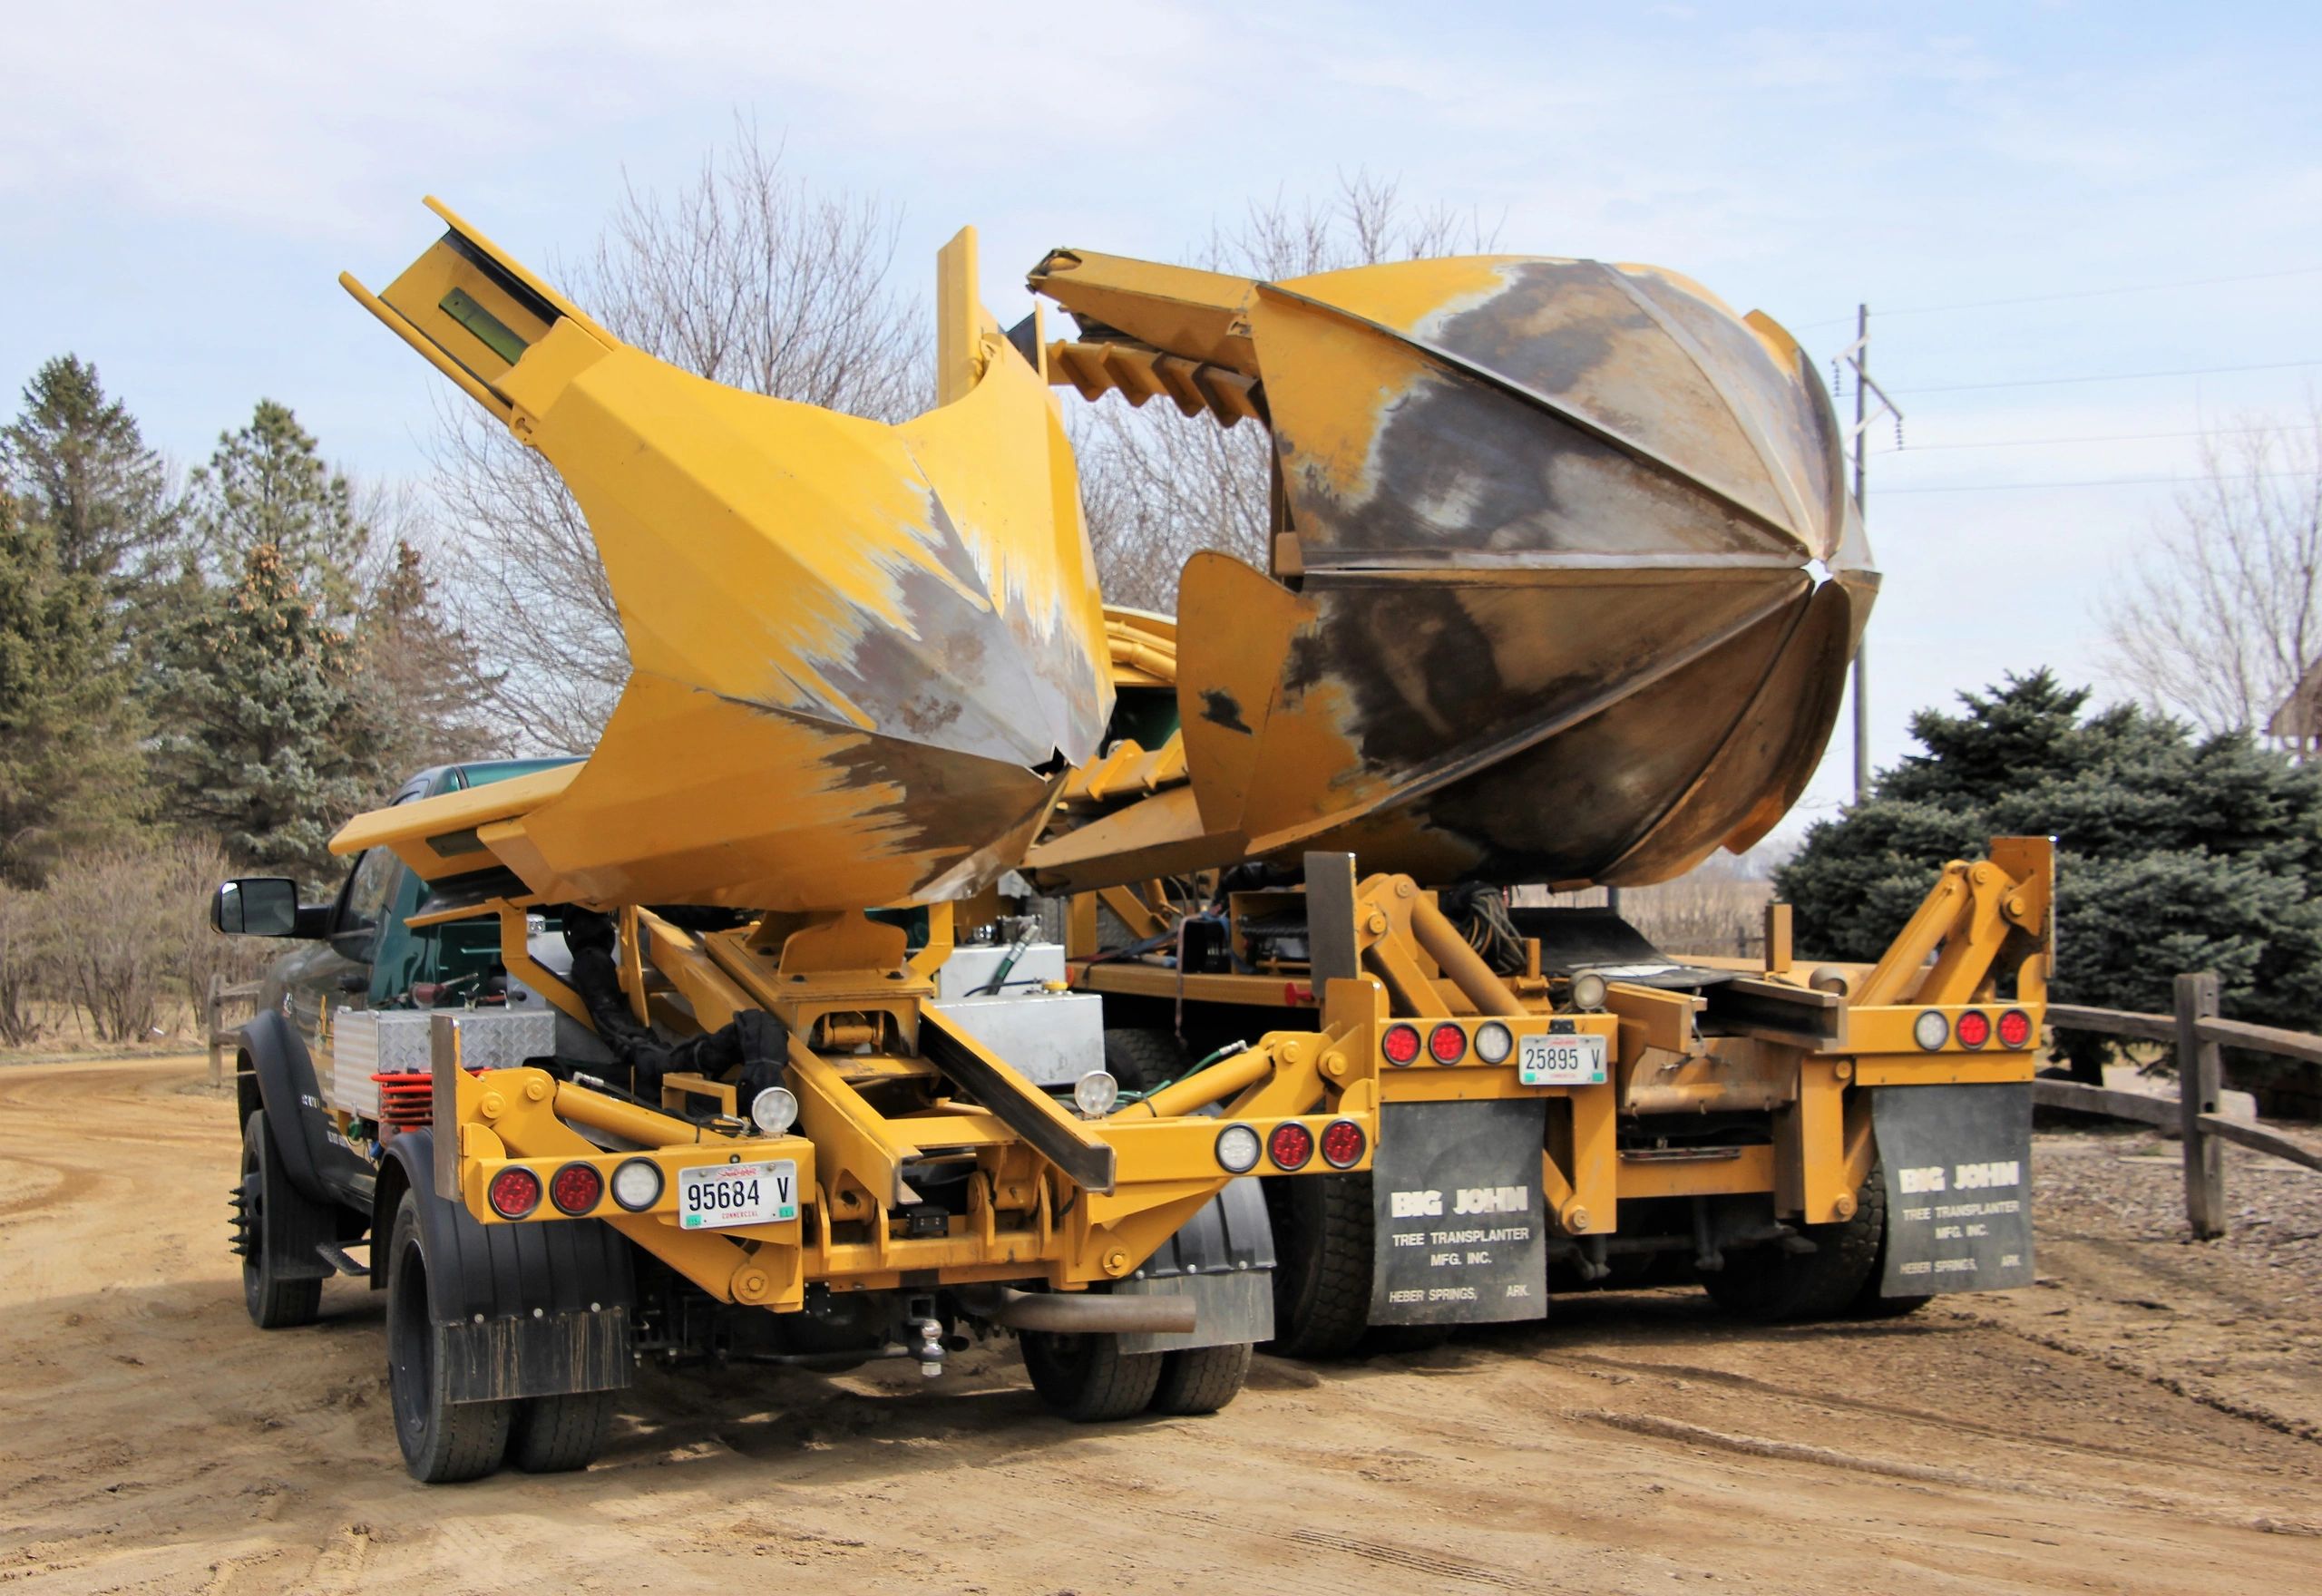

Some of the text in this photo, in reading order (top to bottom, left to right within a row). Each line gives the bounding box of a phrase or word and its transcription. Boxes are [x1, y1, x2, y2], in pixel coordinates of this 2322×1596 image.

[1526, 1048, 1600, 1070] 25895 V
[1898, 1161, 2019, 1194] BIG JOHN
[688, 1176, 789, 1212] 95684 V
[1390, 1185, 1528, 1218] BIG JOHN
[1902, 1200, 2020, 1221] TREE TRANSPLANTER
[1392, 1227, 1529, 1247] TREE TRANSPLANTER
[1430, 1251, 1492, 1267] MFG. INC.
[1899, 1261, 1931, 1275] HEBER
[1389, 1284, 1531, 1303] HEBER SPRINGS, ARK.
